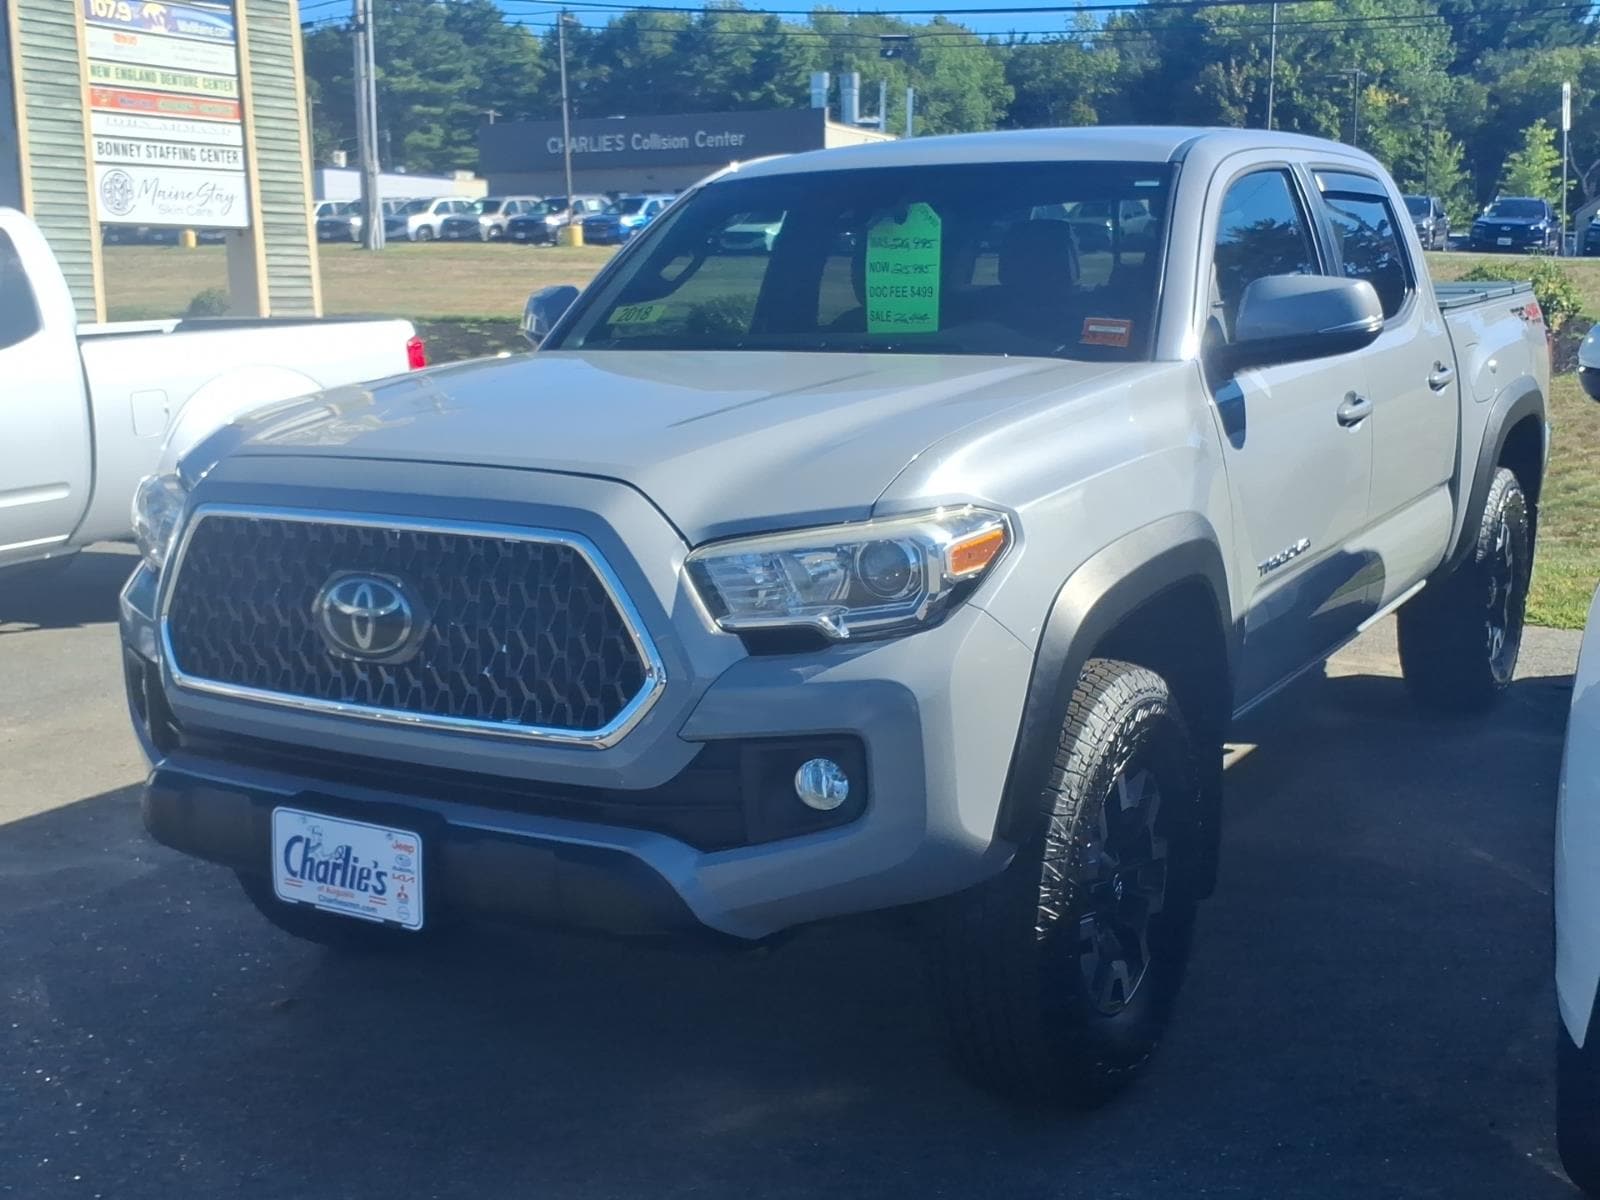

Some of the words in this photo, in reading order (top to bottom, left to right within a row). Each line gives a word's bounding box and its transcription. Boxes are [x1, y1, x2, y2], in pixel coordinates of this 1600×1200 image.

[90, 64, 110, 78] NEW
[115, 67, 158, 84] ENGLAND
[160, 72, 200, 90] DENTURE
[202, 76, 233, 92] CENTER
[546, 134, 625, 154] CHARLIE'S
[631, 133, 690, 151] Collision
[694, 131, 745, 148] Center
[97, 141, 142, 159] BONNEY
[145, 145, 197, 162] STAFFING
[199, 148, 240, 164] CENTER
[869, 261, 890, 273] NOW
[869, 286, 888, 298] DOC
[889, 286, 908, 298] FEE
[869, 310, 892, 322] SALE
[392, 840, 416, 854] Jeep
[284, 834, 388, 897] Charlie's
